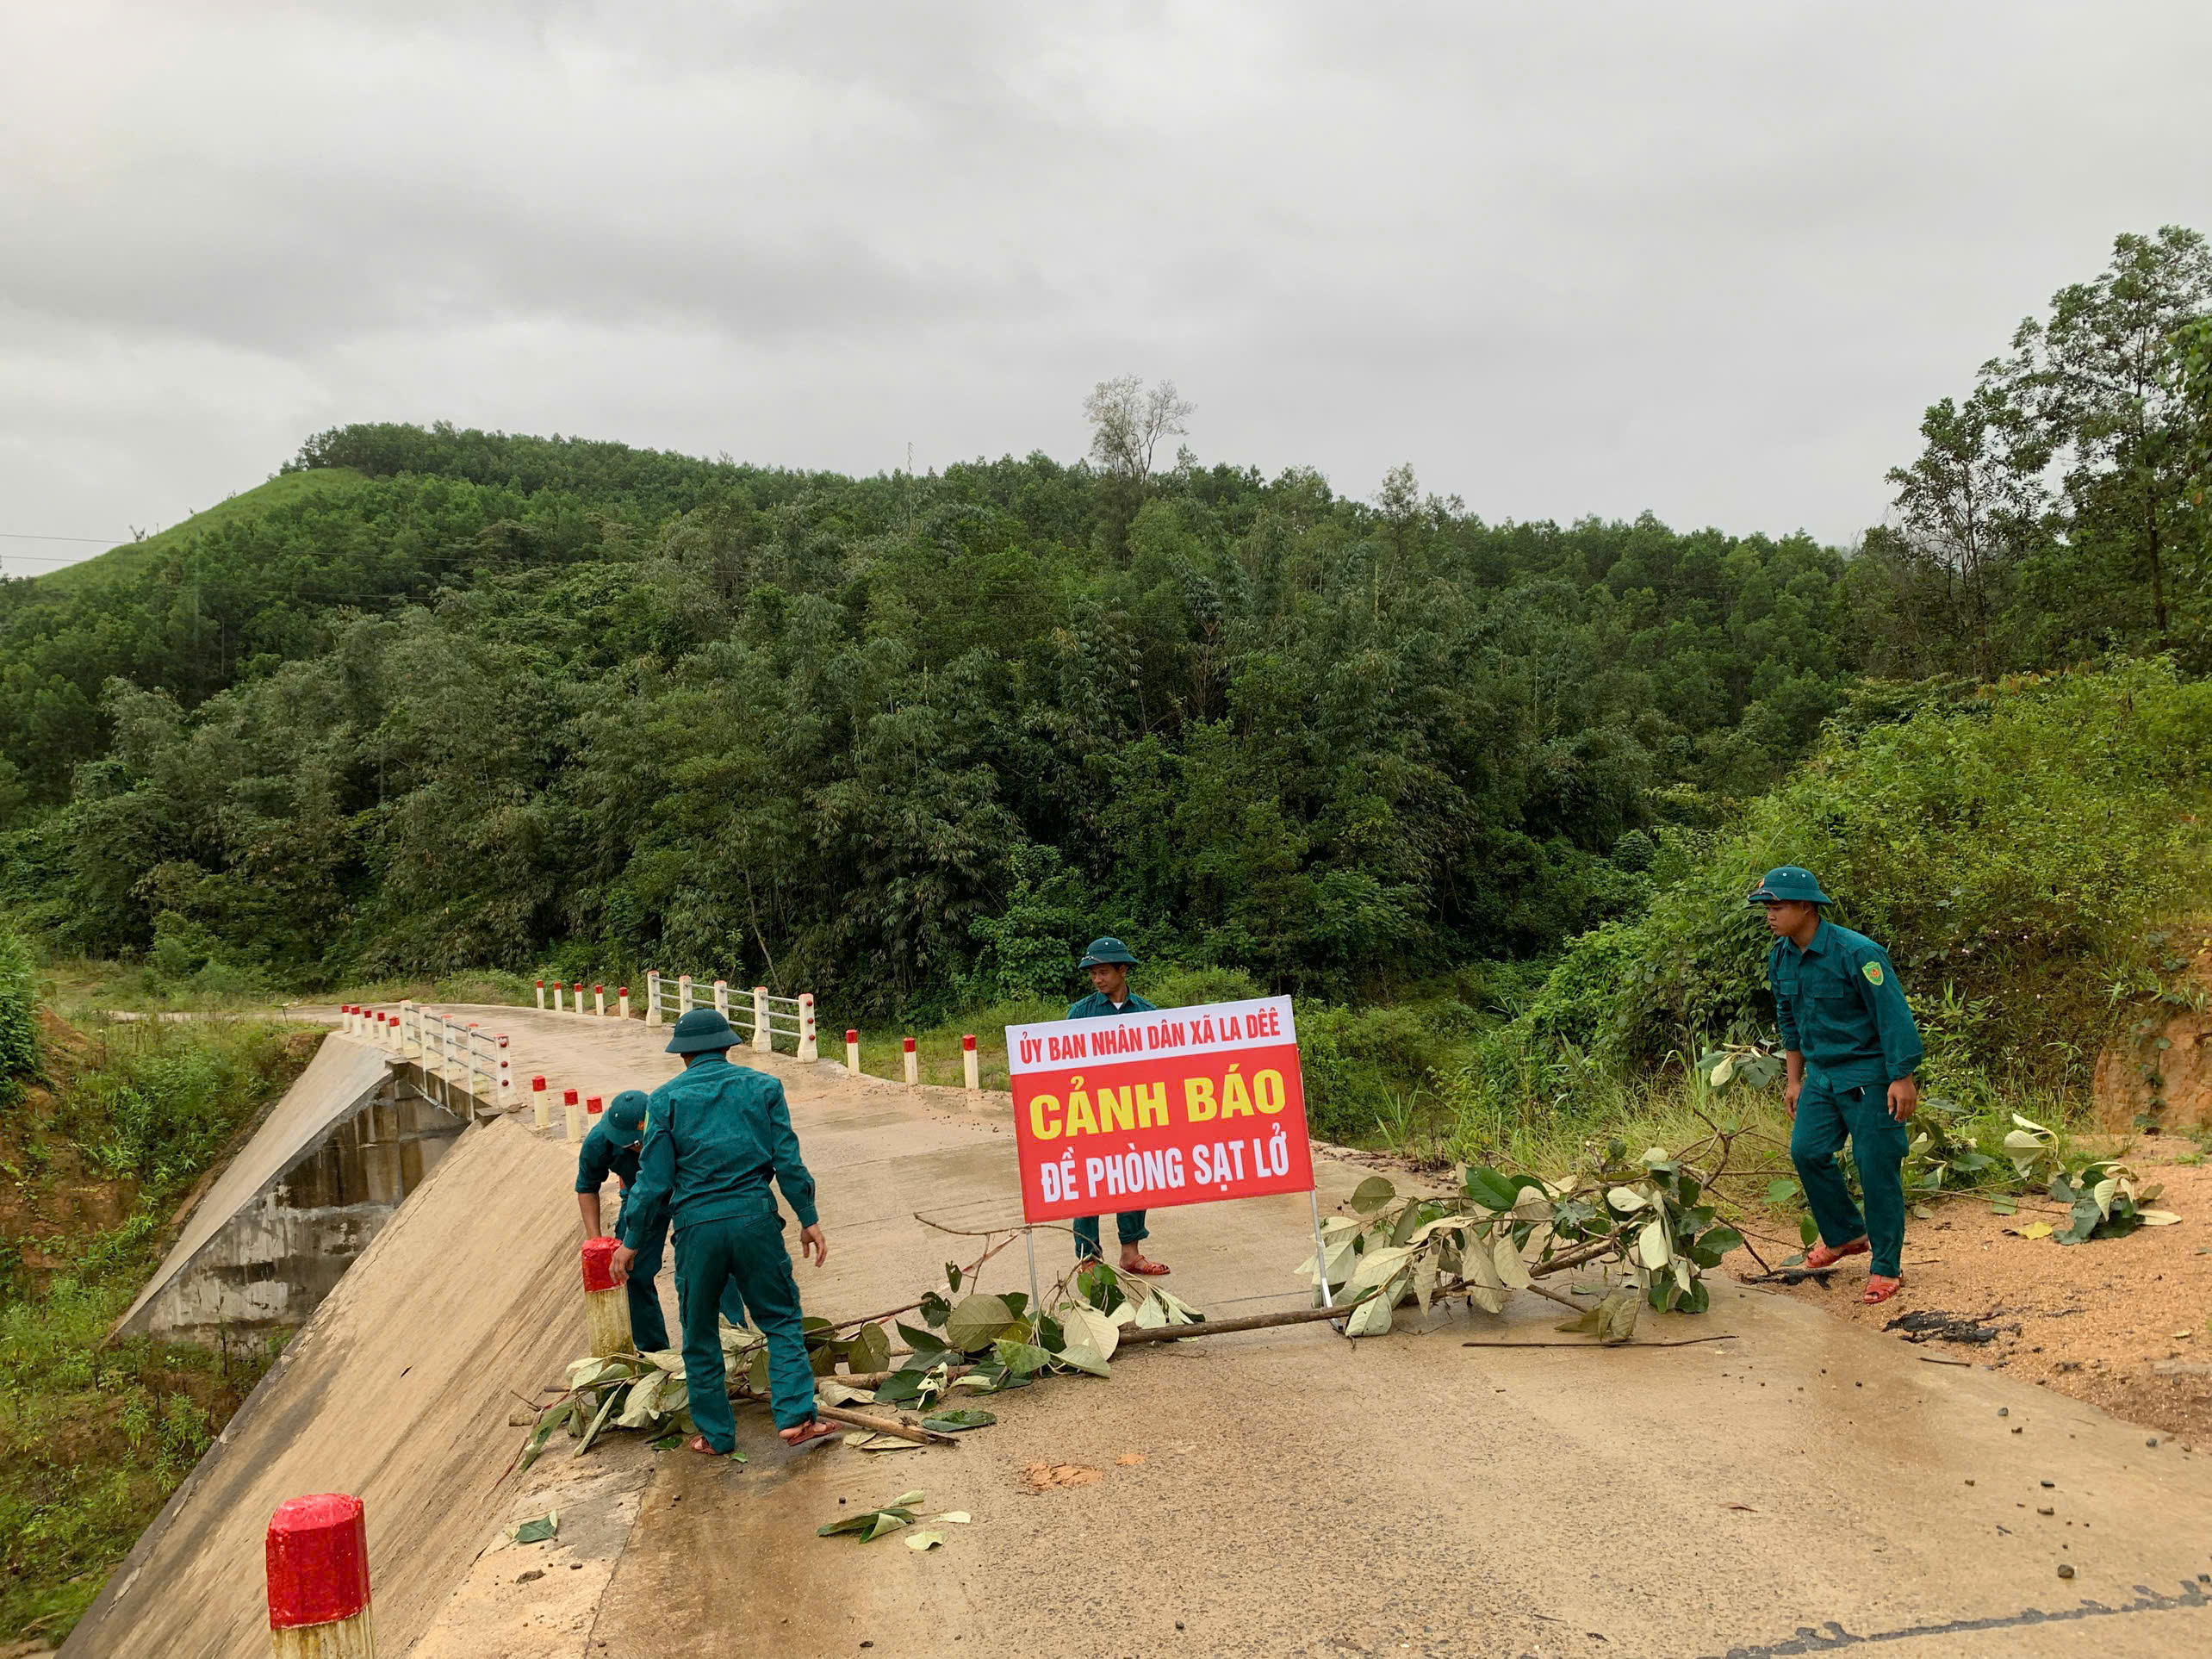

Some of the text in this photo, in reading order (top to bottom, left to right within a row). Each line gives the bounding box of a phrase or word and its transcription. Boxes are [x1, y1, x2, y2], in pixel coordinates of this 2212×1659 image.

[1019, 1006, 1281, 1065] ỦY BAN NHÂN DÂN XÃ LA DÊÊ
[1029, 1063, 1286, 1140] CẢNH BÁO
[1041, 1122, 1289, 1203] ĐỀ PHÒNG SẠT LỞ
